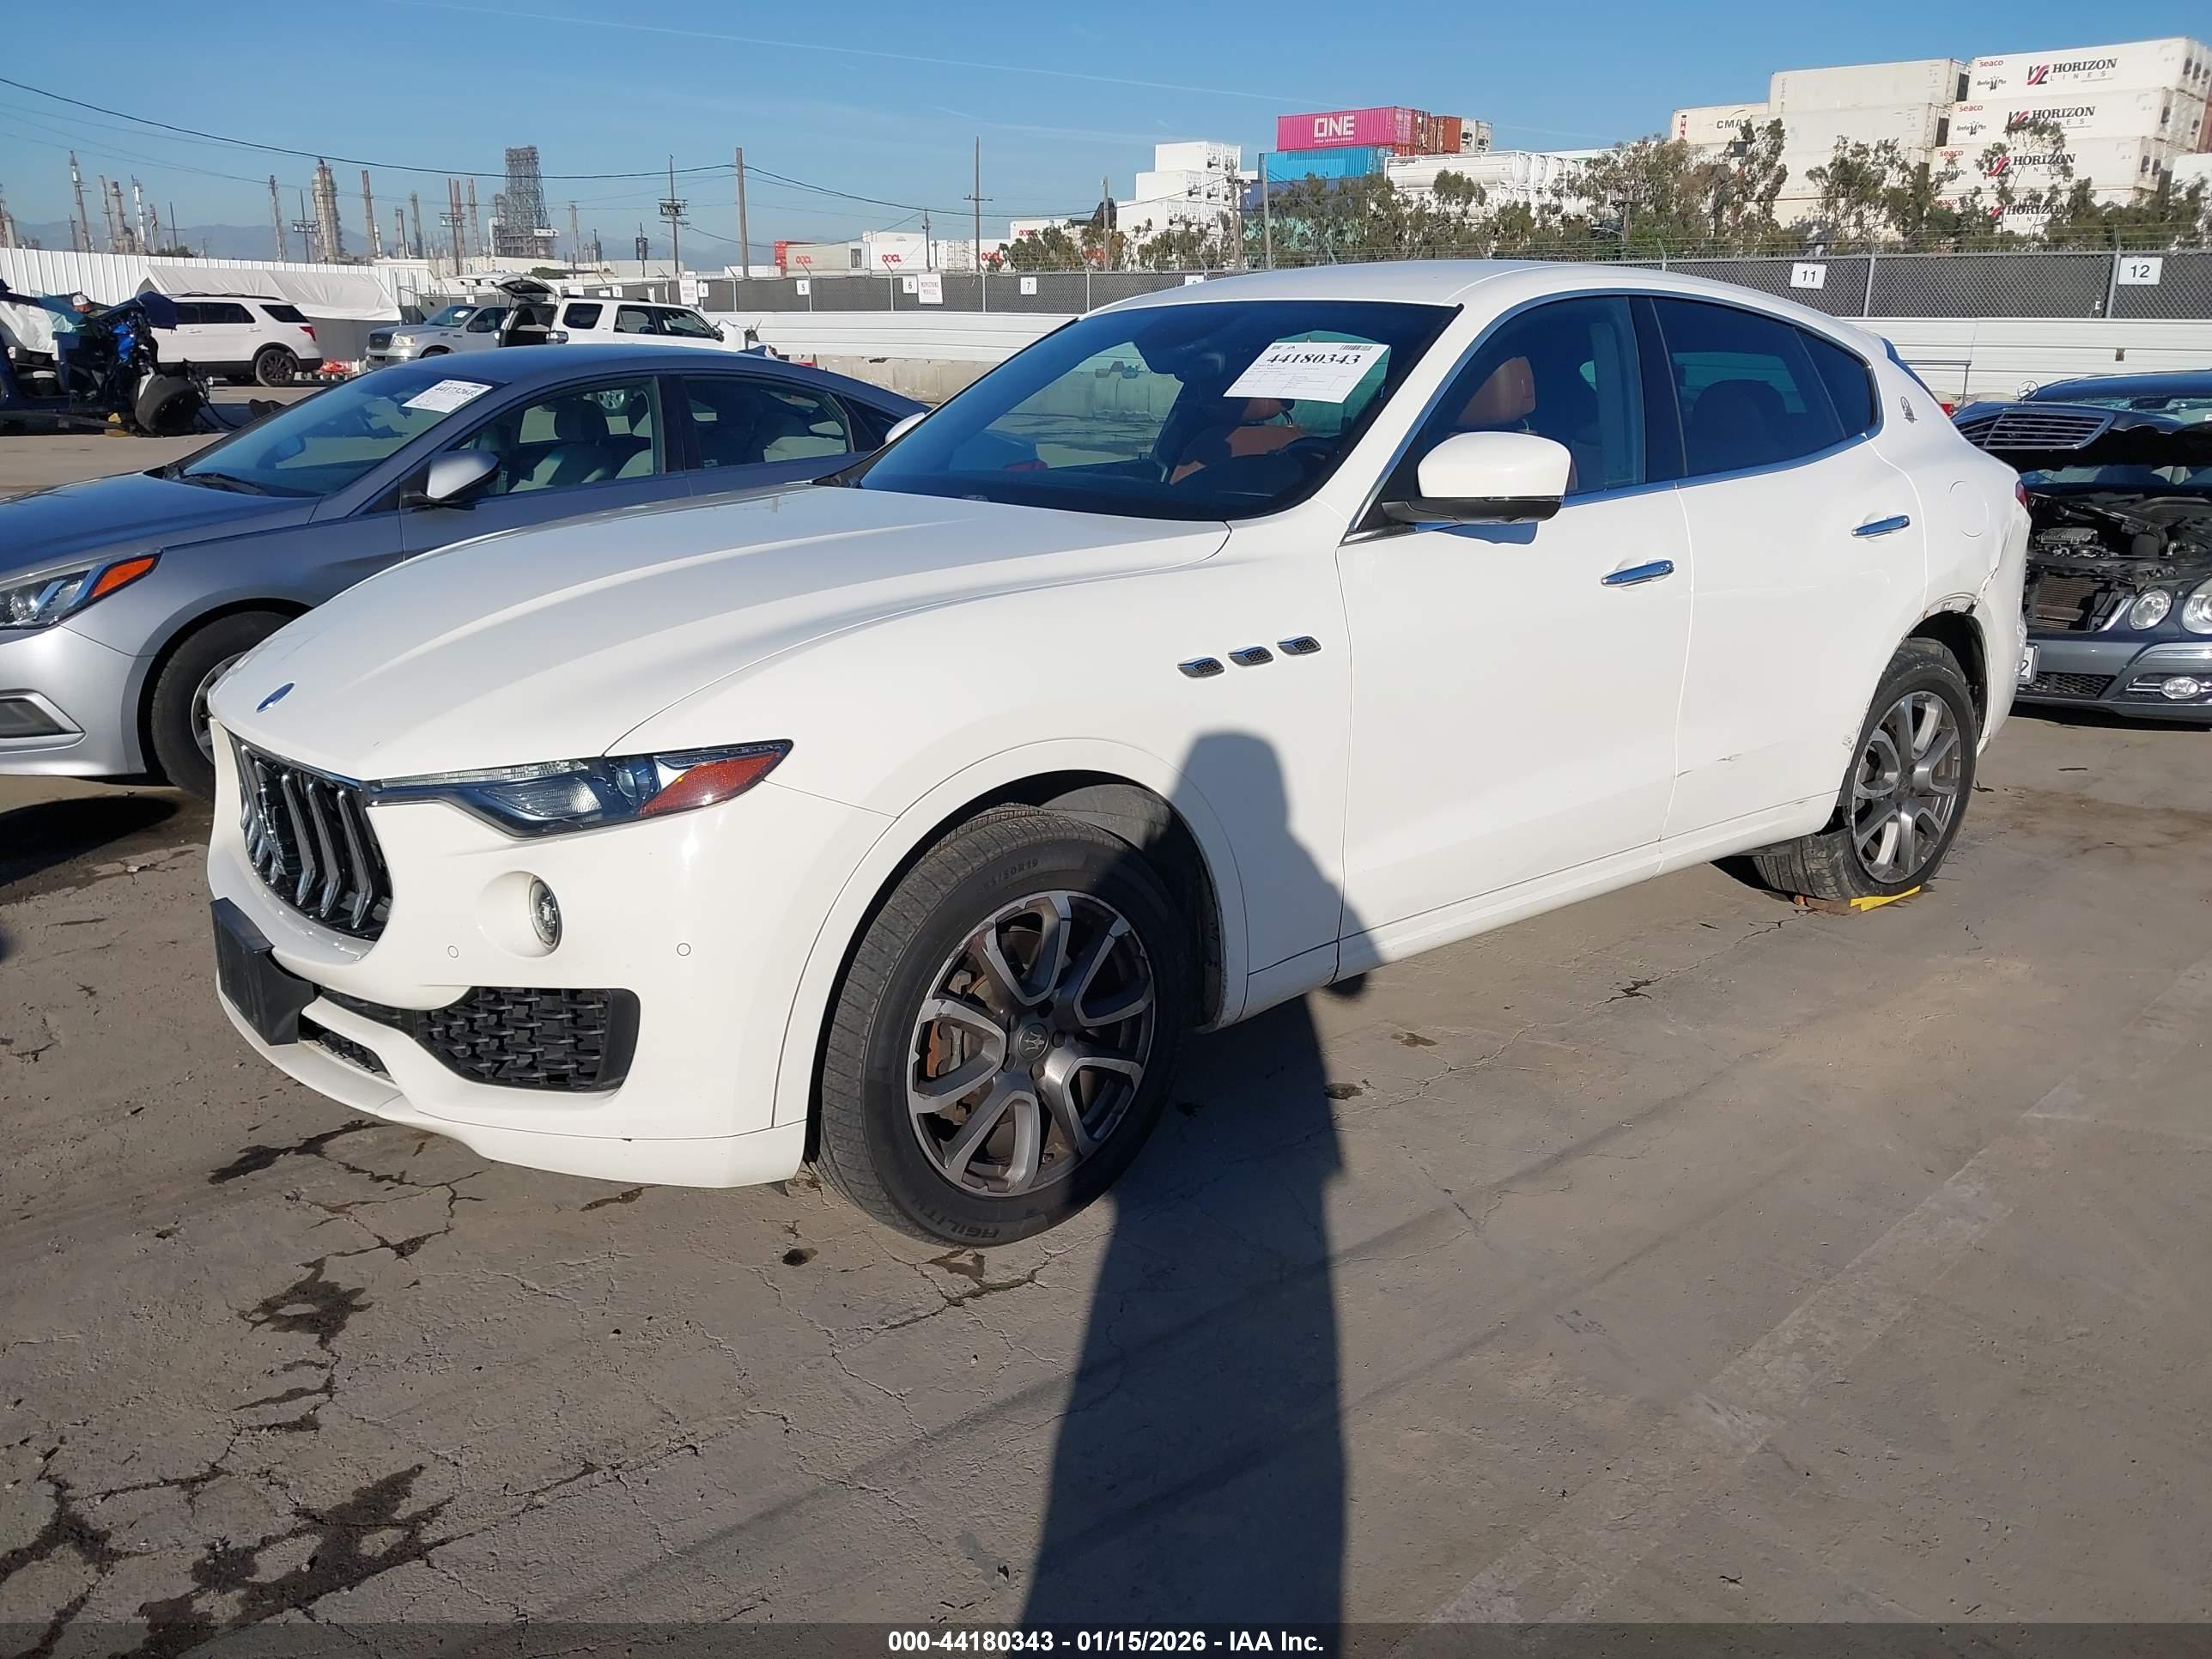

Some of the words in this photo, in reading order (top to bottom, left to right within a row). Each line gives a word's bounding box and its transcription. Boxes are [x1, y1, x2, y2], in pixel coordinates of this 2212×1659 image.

[1978, 59, 2004, 68] seaco
[2052, 58, 2118, 73] HORIZON
[2050, 70, 2106, 81] LINES
[2032, 106, 2095, 119] HORIZON
[1314, 115, 1355, 137] ONE
[2012, 153, 2076, 166] HORIZON
[882, 253, 902, 263] OOCL
[1802, 270, 1816, 283] 11
[2130, 264, 2150, 278] 12
[1267, 354, 1361, 365] 44180343
